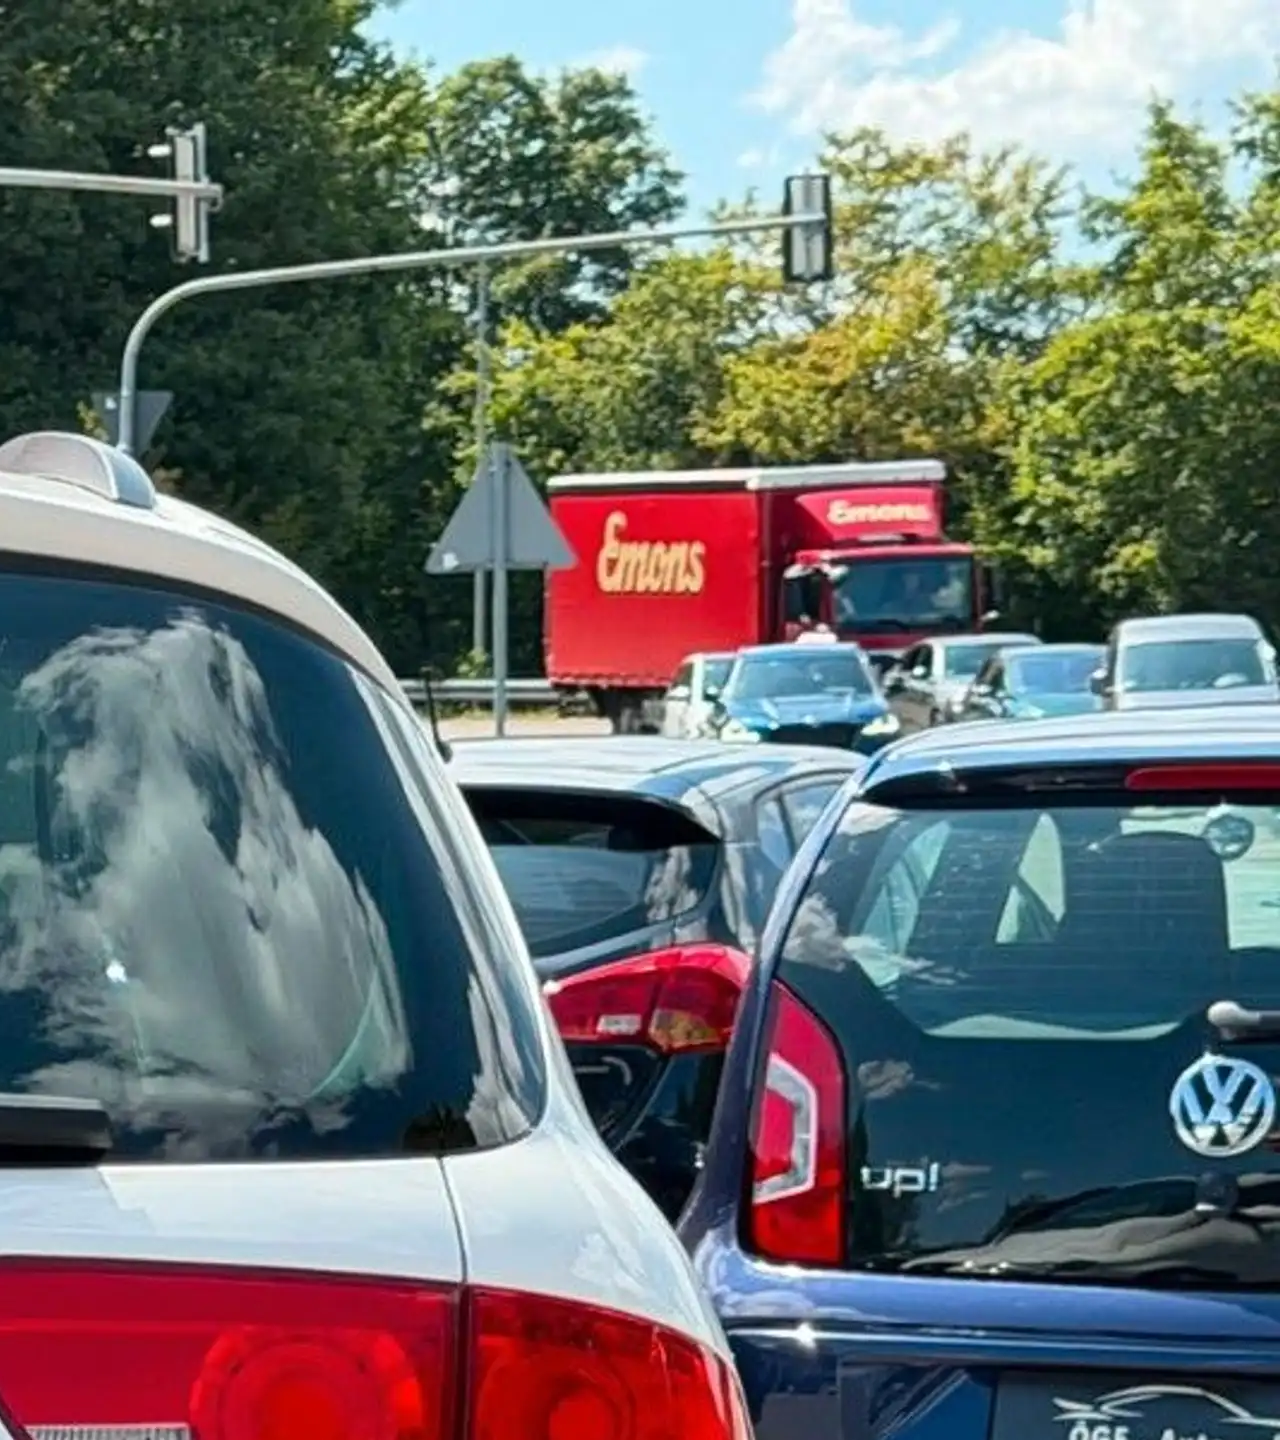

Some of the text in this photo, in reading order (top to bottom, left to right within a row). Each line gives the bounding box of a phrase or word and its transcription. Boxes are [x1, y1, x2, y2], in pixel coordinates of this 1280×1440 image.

[827, 500, 933, 525] Emons
[597, 511, 706, 594] Emons
[861, 1162, 940, 1197] up!
